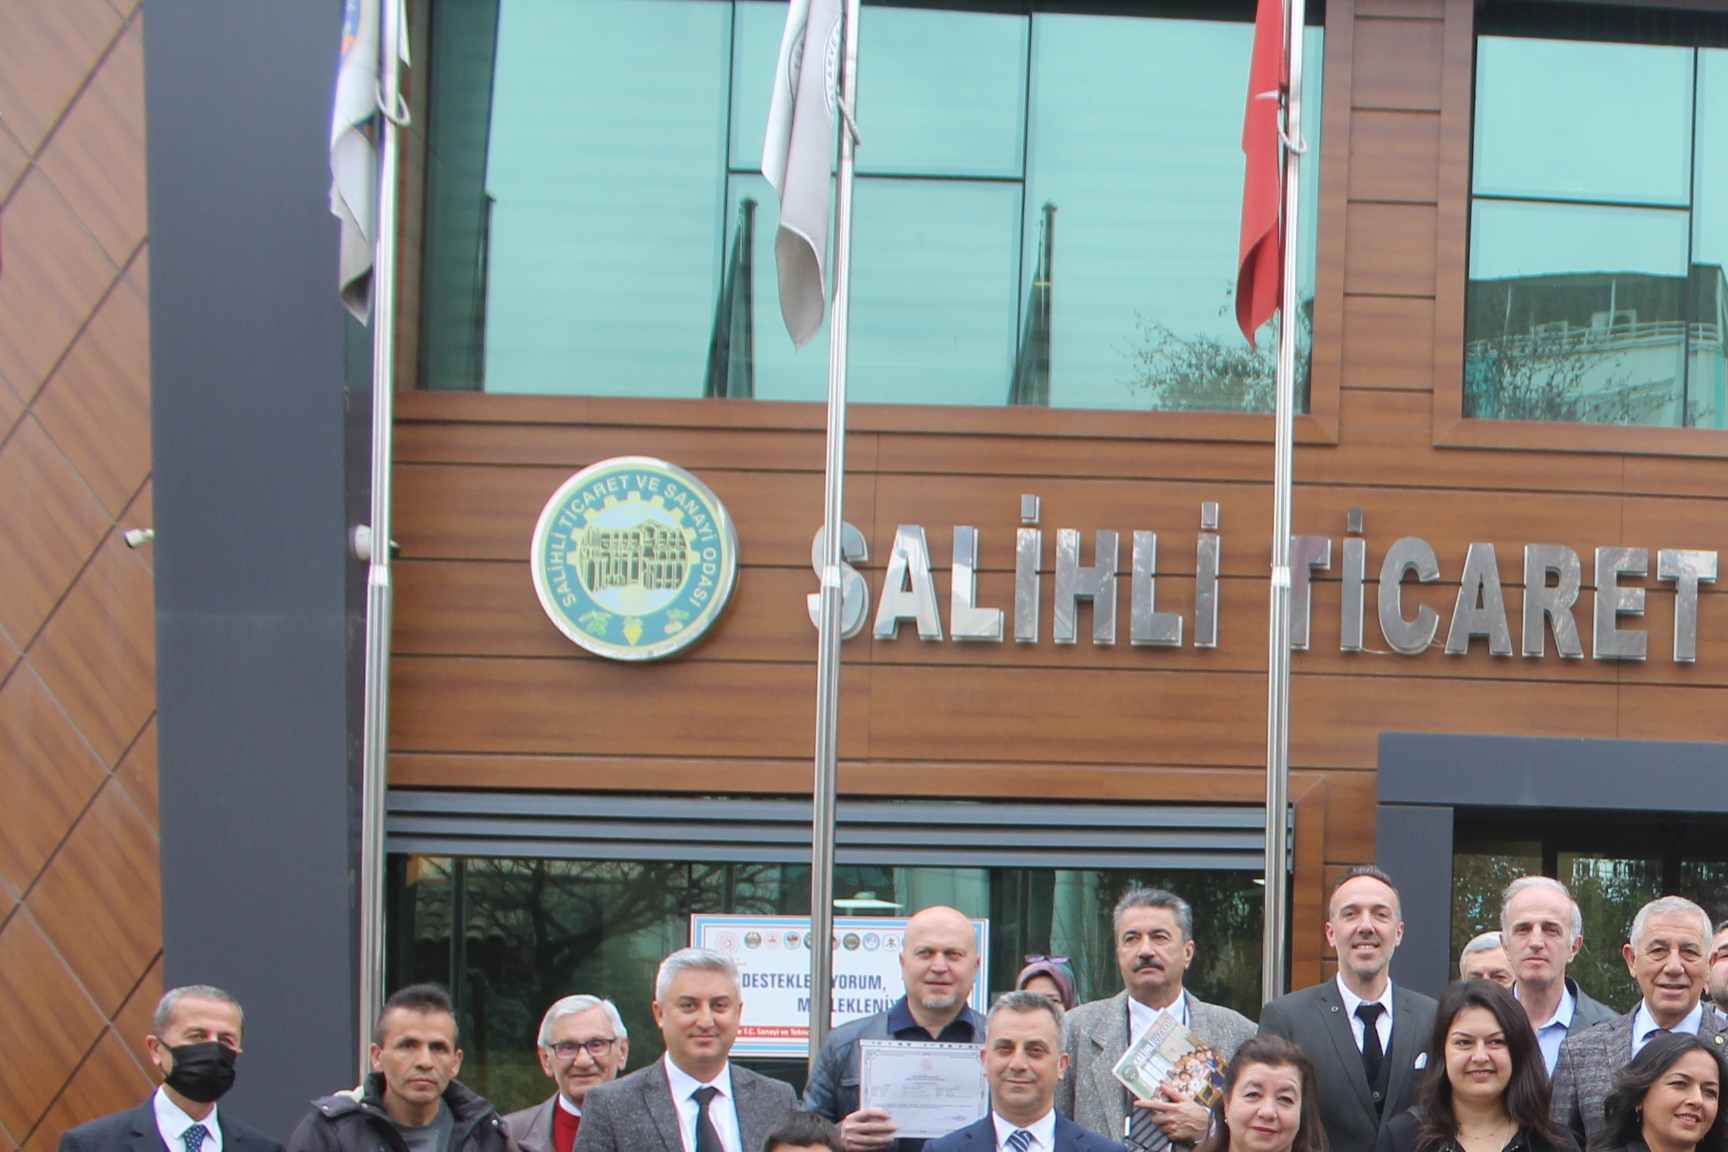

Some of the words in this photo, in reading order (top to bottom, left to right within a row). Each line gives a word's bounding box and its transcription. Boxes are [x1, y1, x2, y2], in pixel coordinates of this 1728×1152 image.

[559, 475, 629, 529] TİCARET
[635, 474, 661, 492] VE
[807, 494, 1222, 648] SALİHLİ
[1290, 506, 1719, 663] TİCARET
